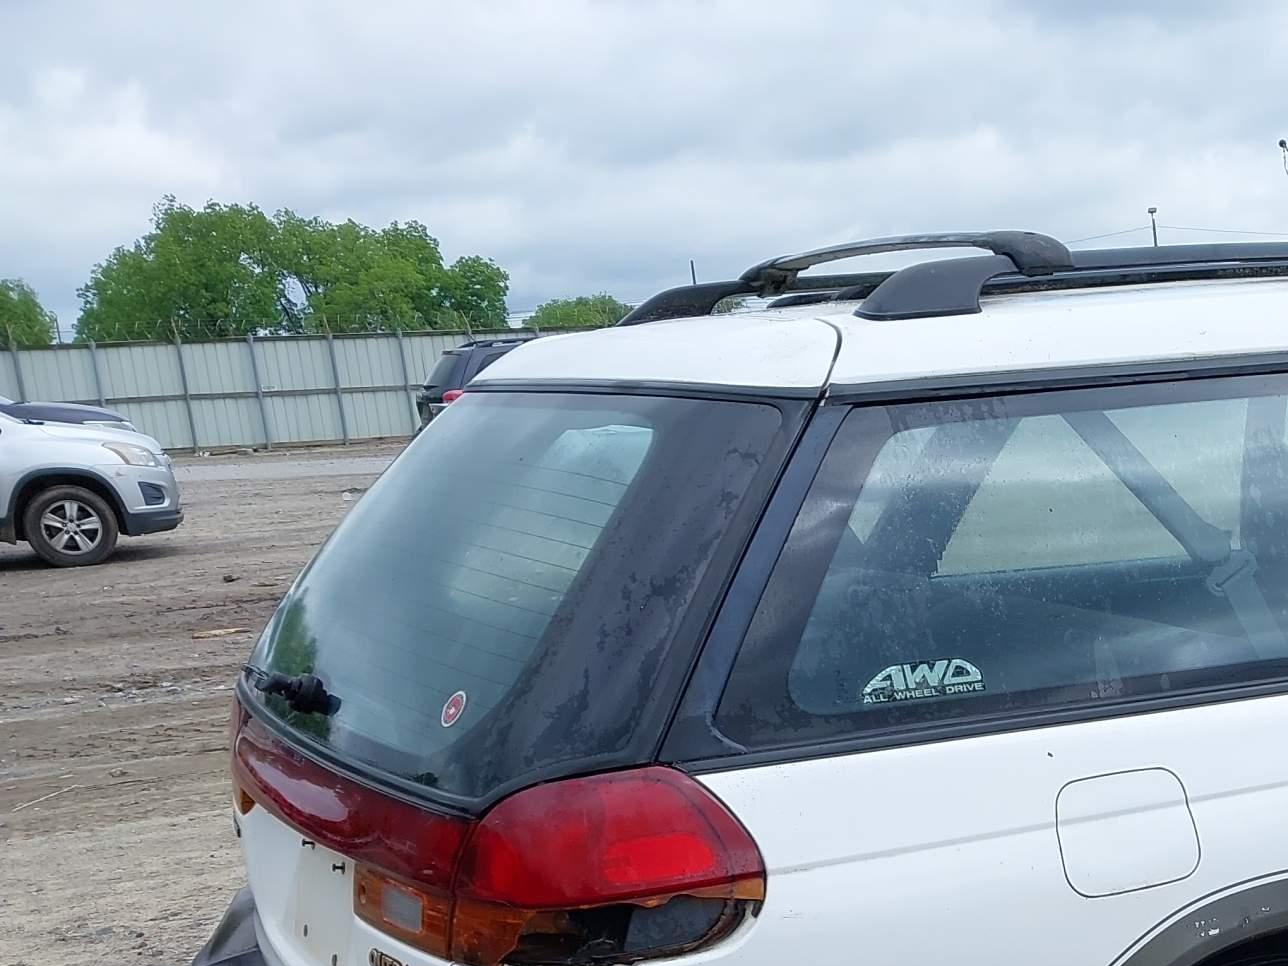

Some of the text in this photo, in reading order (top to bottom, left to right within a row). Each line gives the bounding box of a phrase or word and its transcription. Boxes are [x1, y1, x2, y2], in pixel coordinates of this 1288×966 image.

[863, 658, 983, 694] AWD
[863, 682, 985, 704] ALL WHEEL DRIVE
